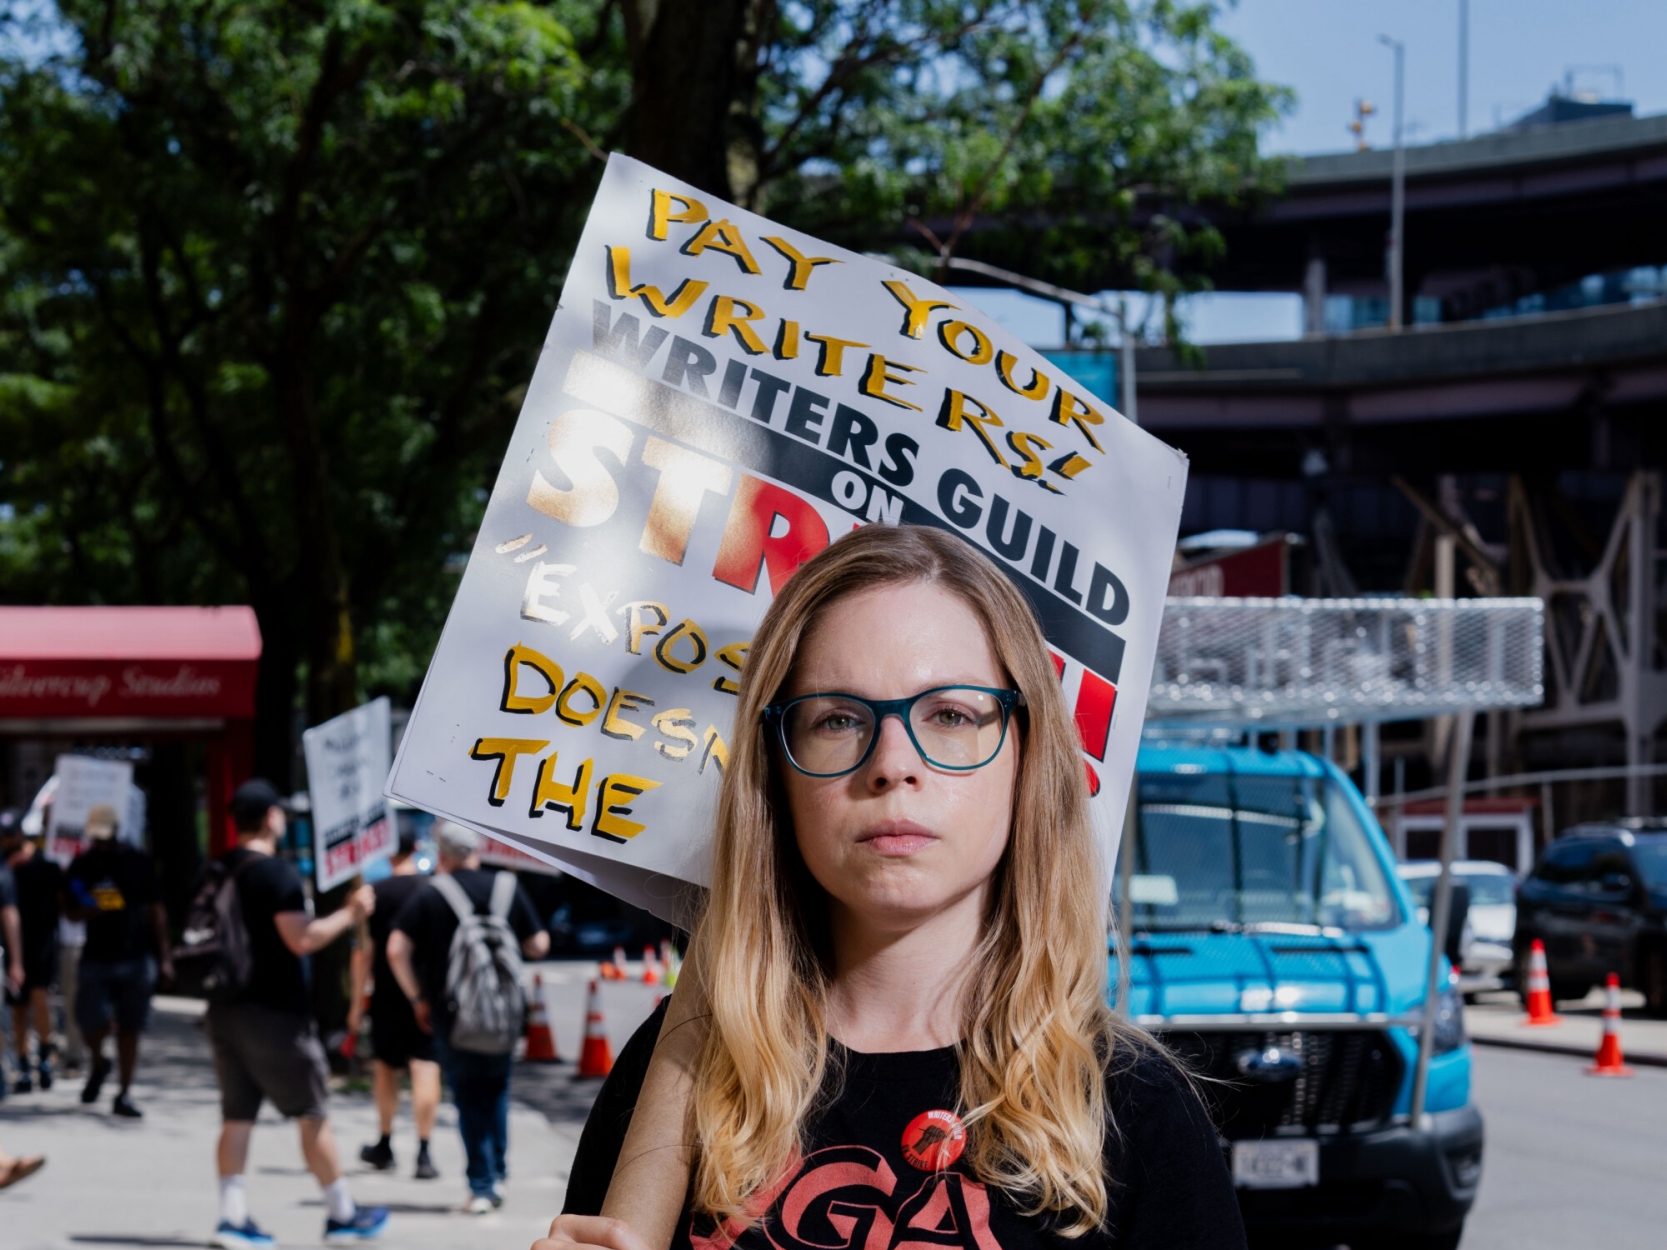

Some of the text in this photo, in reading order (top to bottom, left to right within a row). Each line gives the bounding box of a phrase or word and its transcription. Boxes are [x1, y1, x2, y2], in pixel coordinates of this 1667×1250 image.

[645, 187, 1106, 456] PAY YOUR
[592, 298, 1131, 627] WRITERS GUILD
[830, 469, 904, 527] ON
[467, 735, 665, 845] THE
